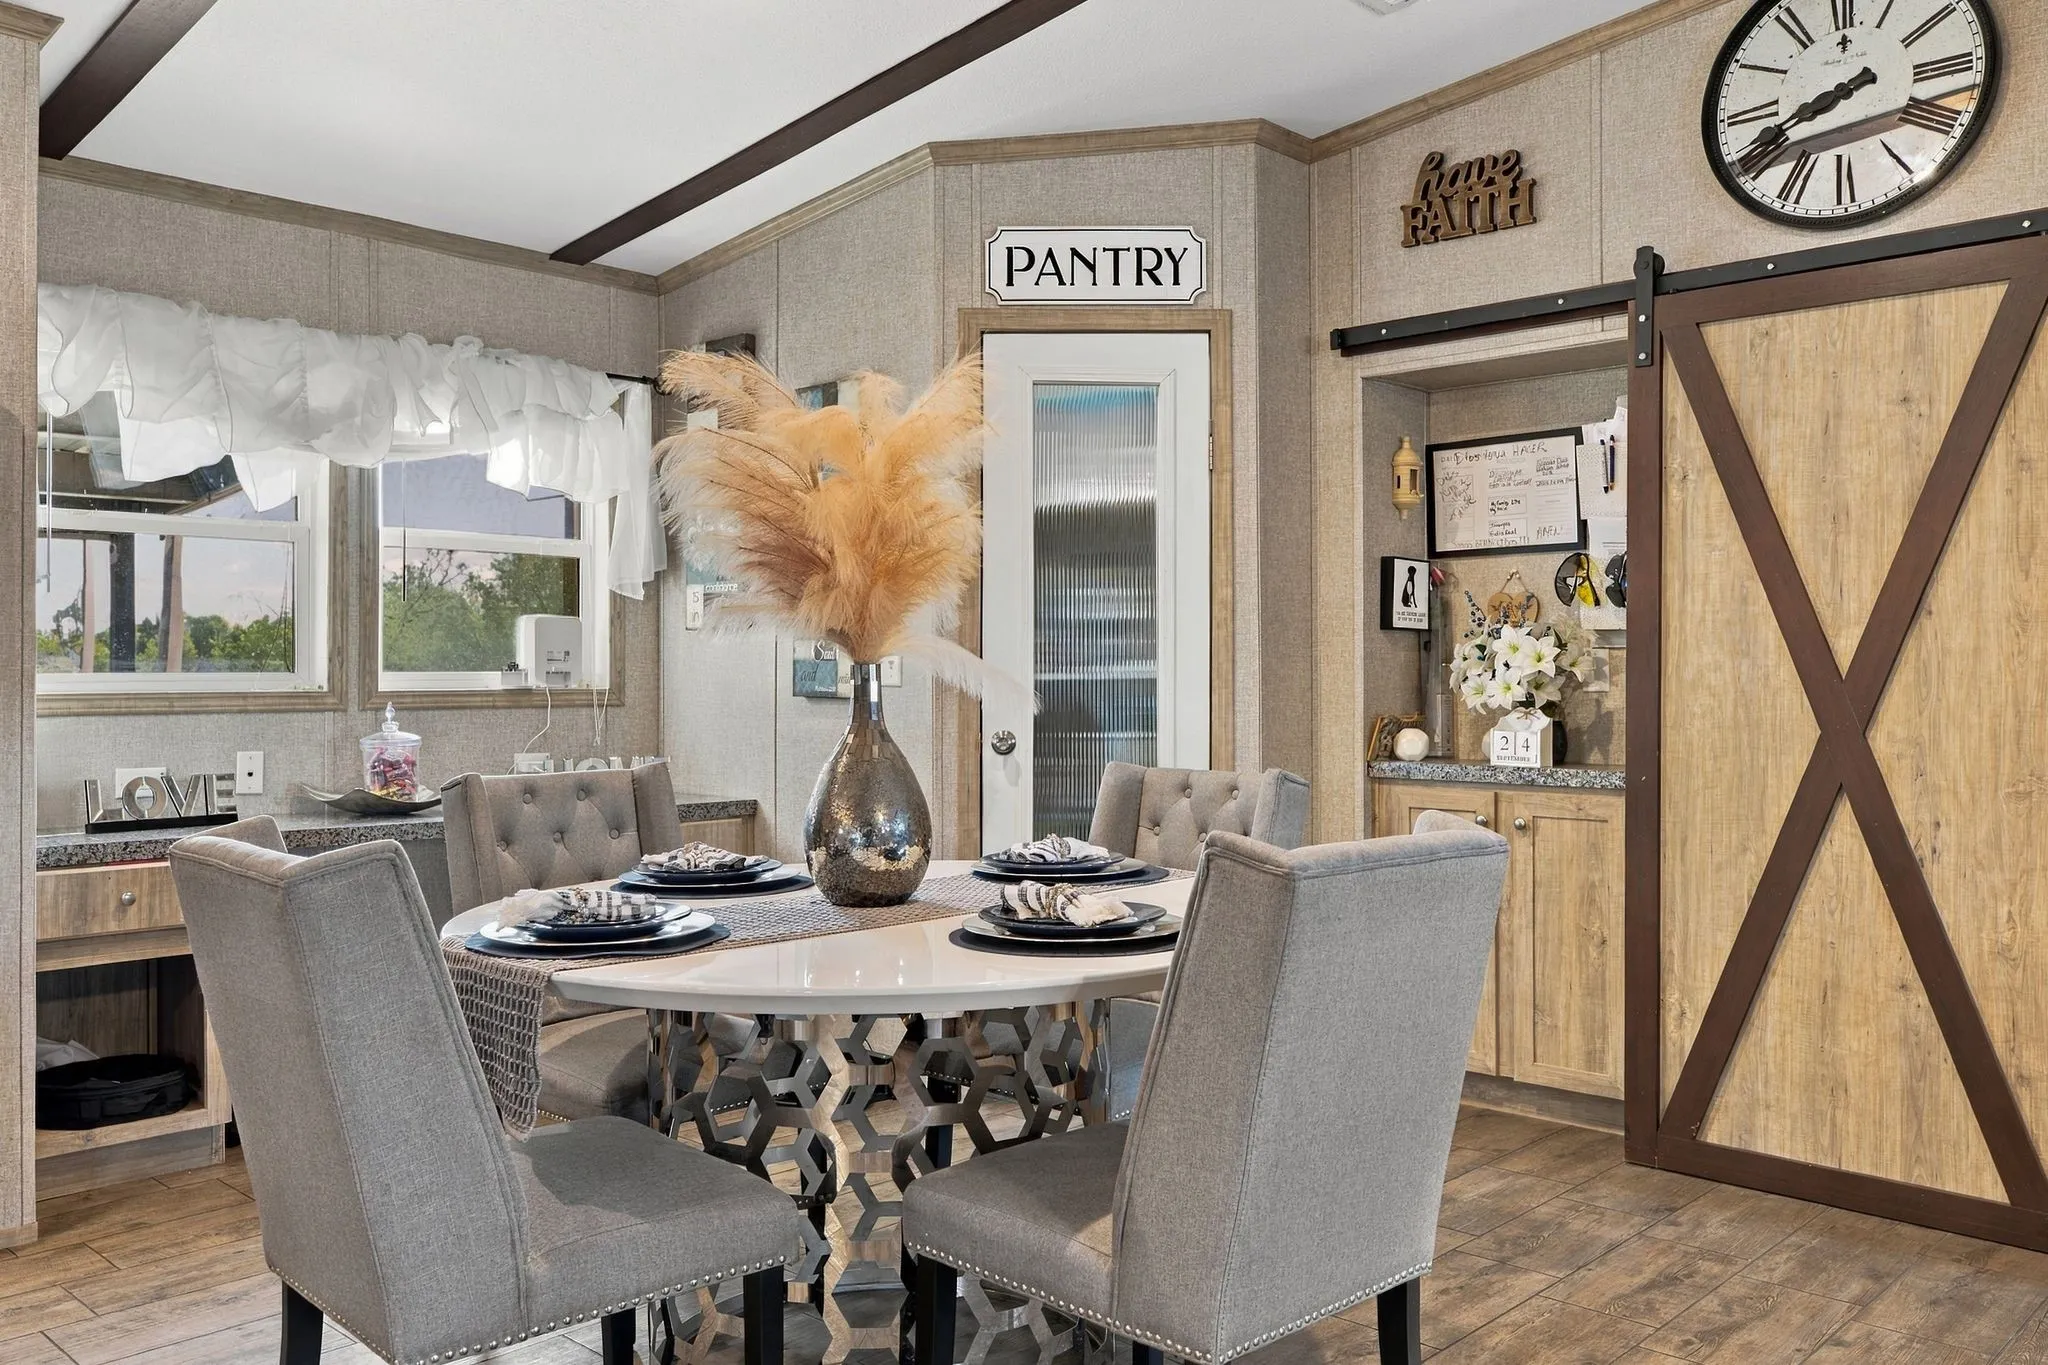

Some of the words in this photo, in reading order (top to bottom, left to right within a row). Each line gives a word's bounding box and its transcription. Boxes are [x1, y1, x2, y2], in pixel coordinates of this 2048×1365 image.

[1913, 51, 1974, 83] III
[1897, 96, 1964, 136] IIII
[1412, 149, 1523, 203] have
[1400, 178, 1537, 248] FAITH
[1005, 246, 1188, 286] PANTRY
[1500, 735, 1509, 751] 2
[1521, 737, 1530, 752] 4
[85, 773, 236, 823] LOVE
